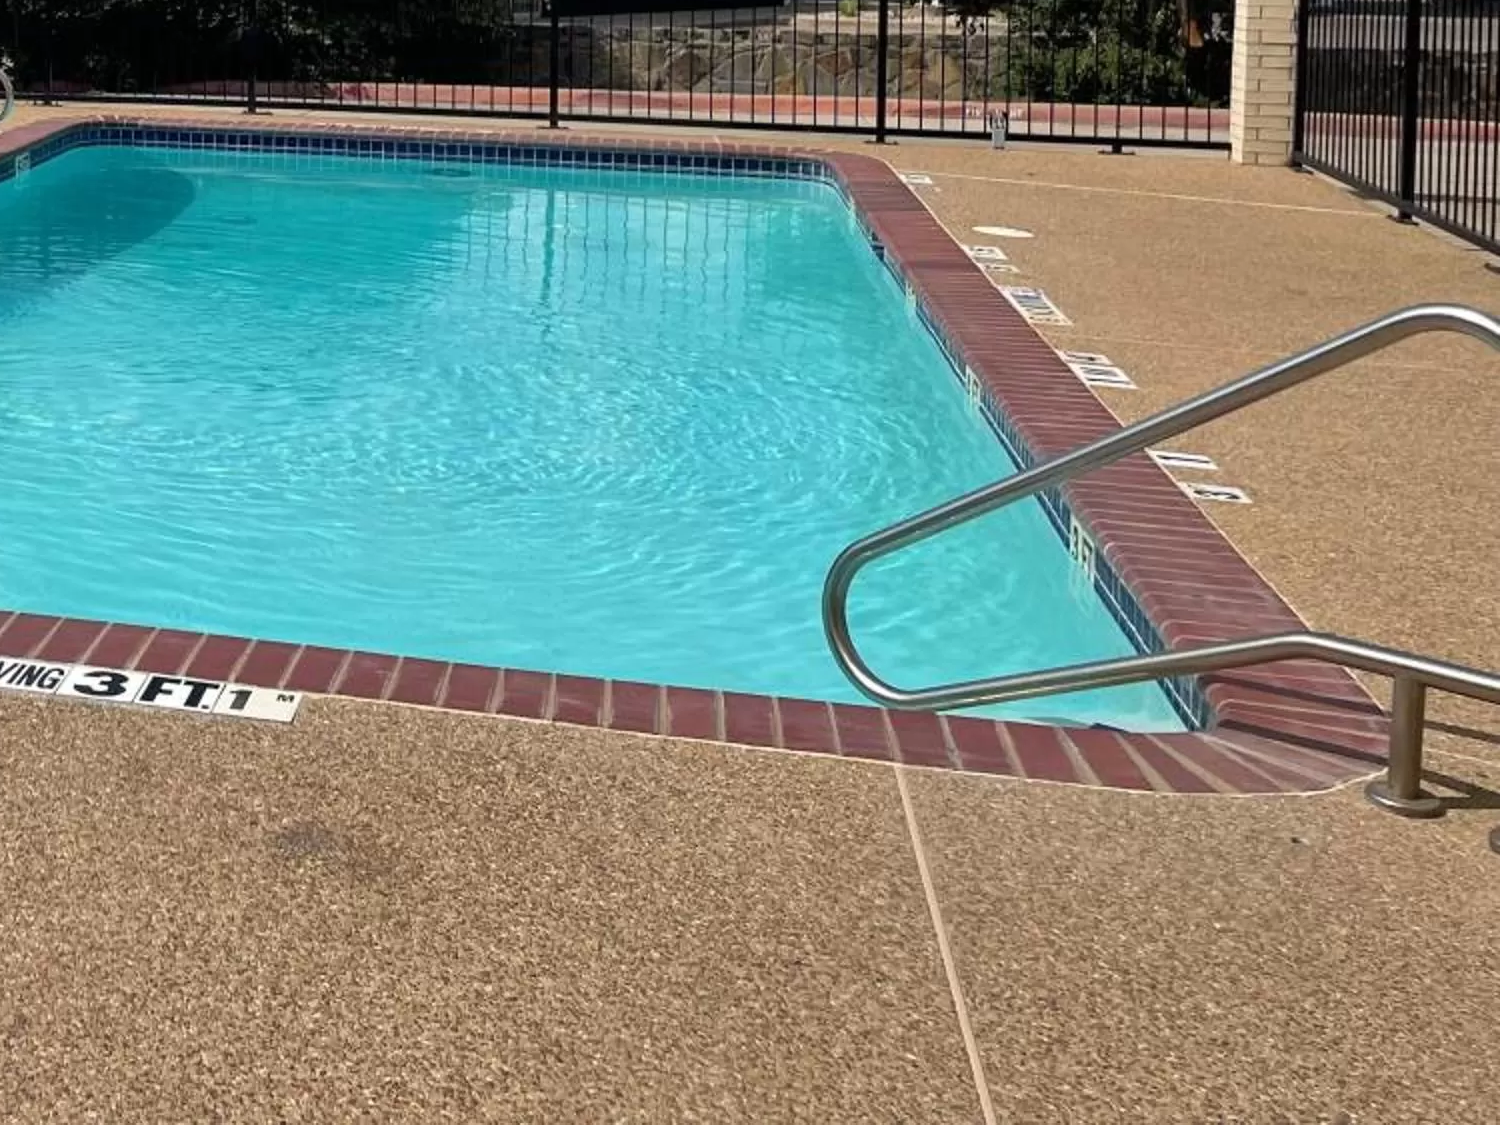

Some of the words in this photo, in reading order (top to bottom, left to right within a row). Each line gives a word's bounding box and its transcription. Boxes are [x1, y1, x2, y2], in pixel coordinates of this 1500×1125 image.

[73, 670, 129, 698] 3
[229, 689, 253, 711] 1
[276, 693, 295, 704] M
